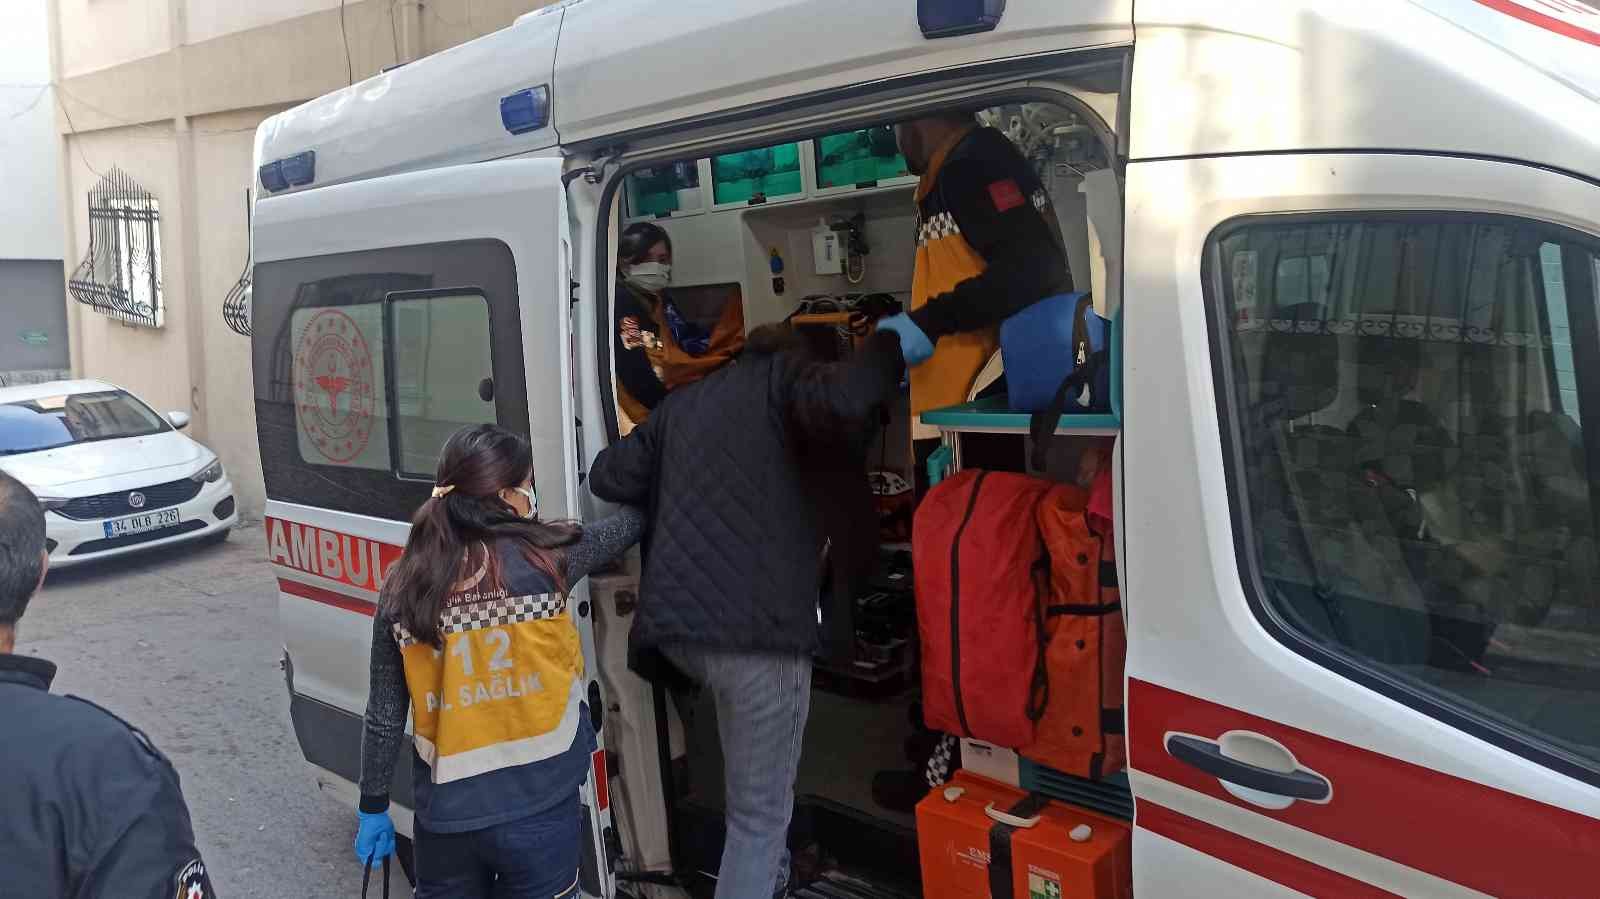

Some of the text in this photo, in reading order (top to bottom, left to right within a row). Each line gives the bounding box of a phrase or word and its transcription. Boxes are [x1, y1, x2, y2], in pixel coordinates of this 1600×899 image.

[113, 520, 127, 533] 34
[265, 519, 384, 592] AMBUL
[432, 628, 514, 677] 12
[459, 670, 544, 708] SAĞLIK
